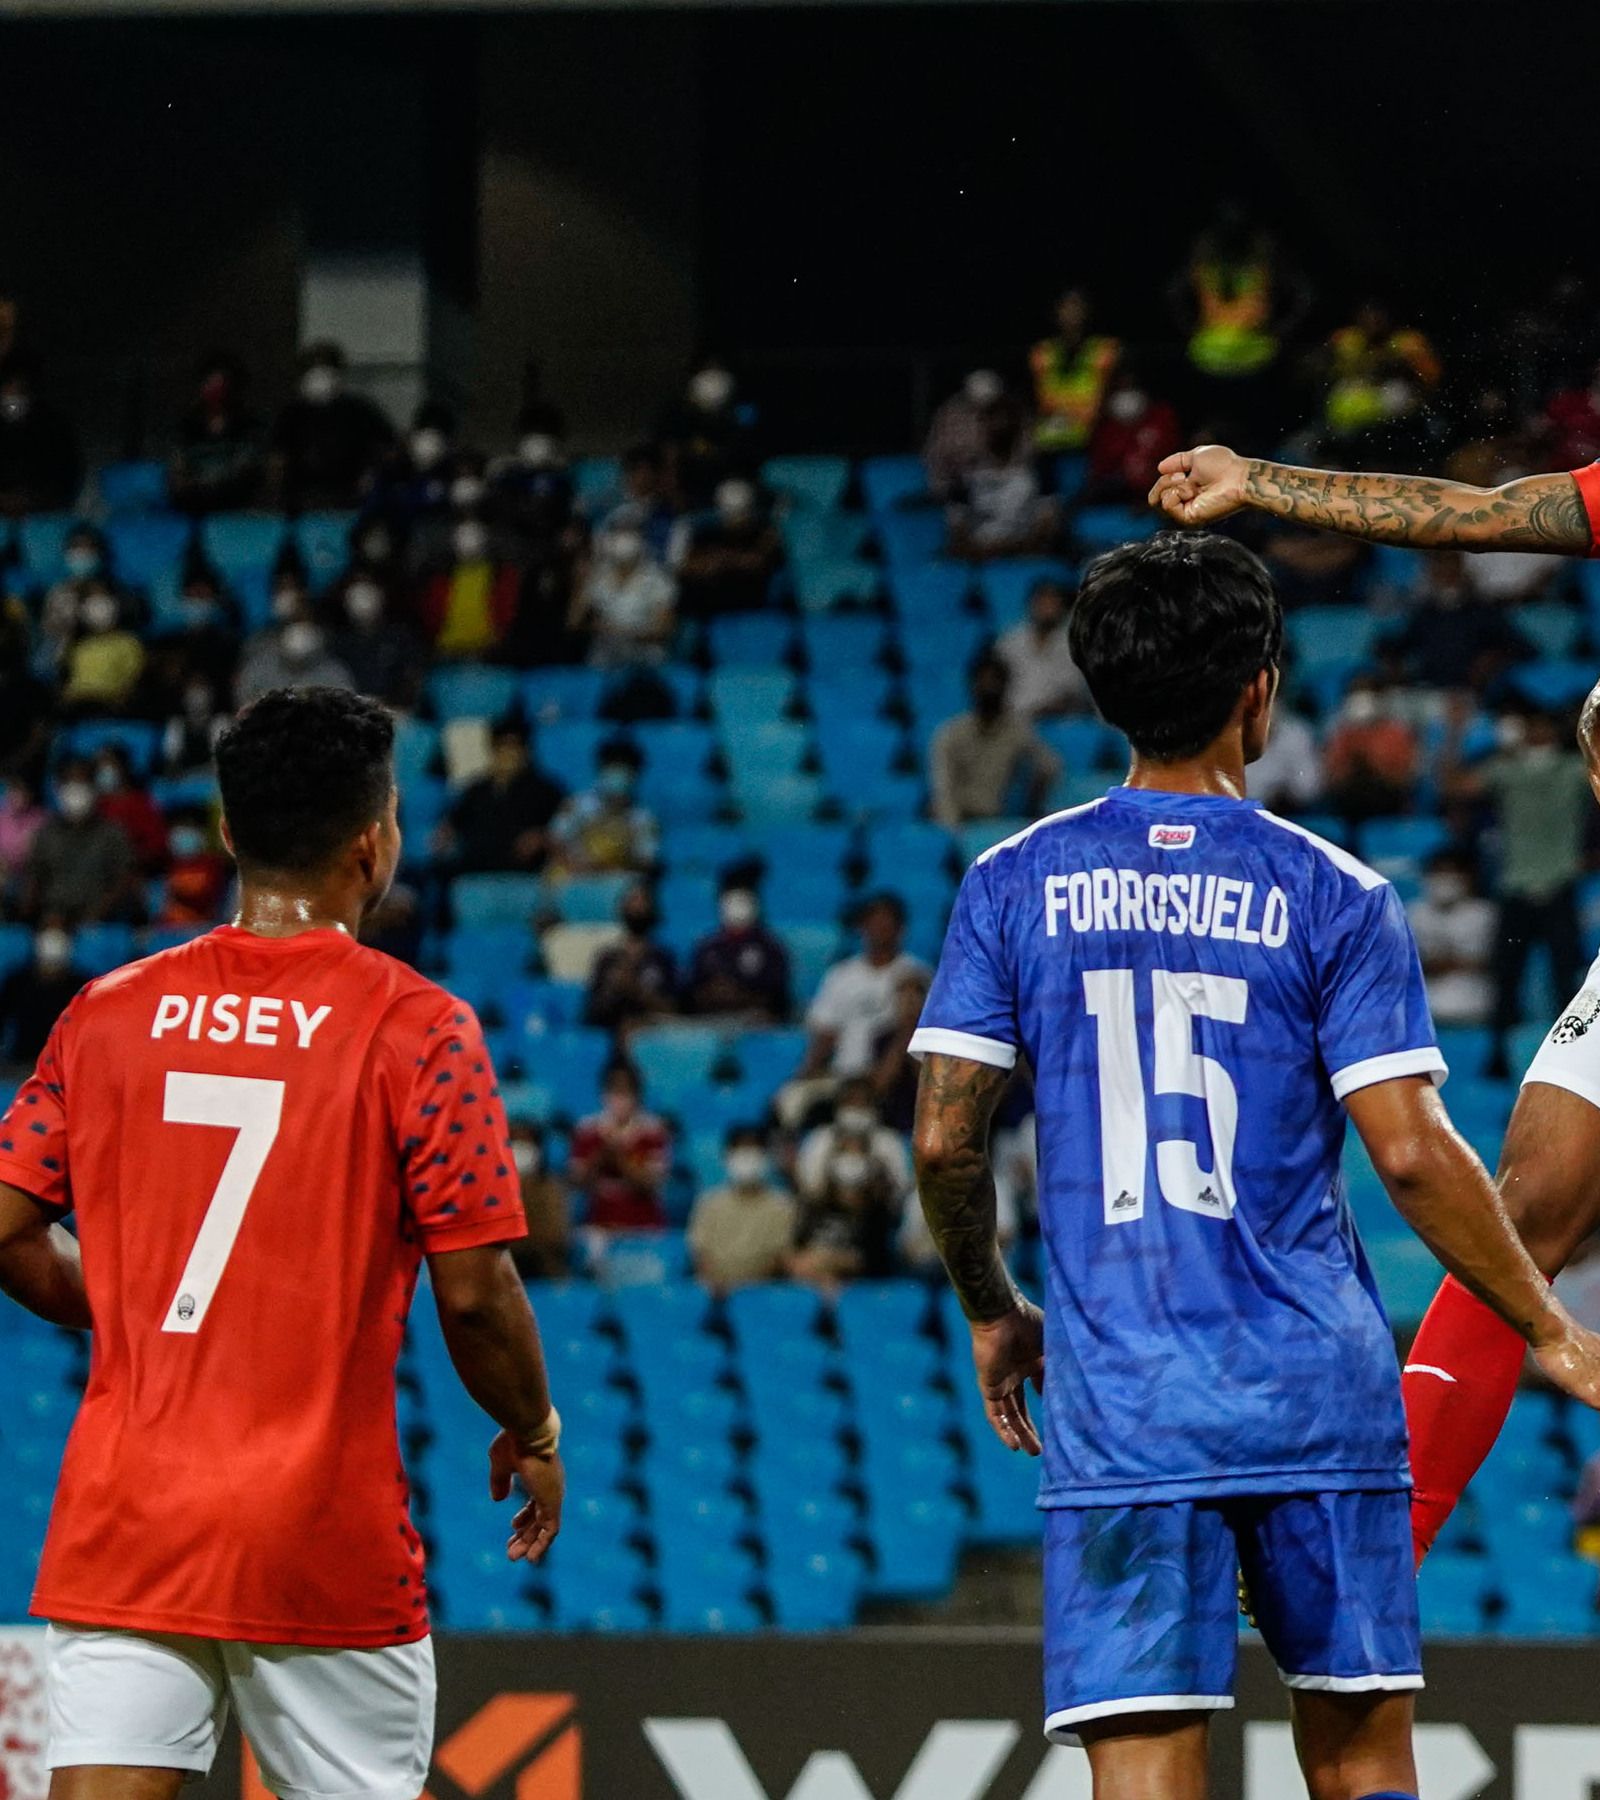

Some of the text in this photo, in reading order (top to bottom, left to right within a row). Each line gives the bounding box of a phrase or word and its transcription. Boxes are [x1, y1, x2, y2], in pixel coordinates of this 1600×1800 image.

[1044, 867, 1290, 949] FORROSUELO
[150, 993, 333, 1048] PISEY
[1081, 968, 1248, 1225] 15
[160, 1070, 286, 1334] 7
